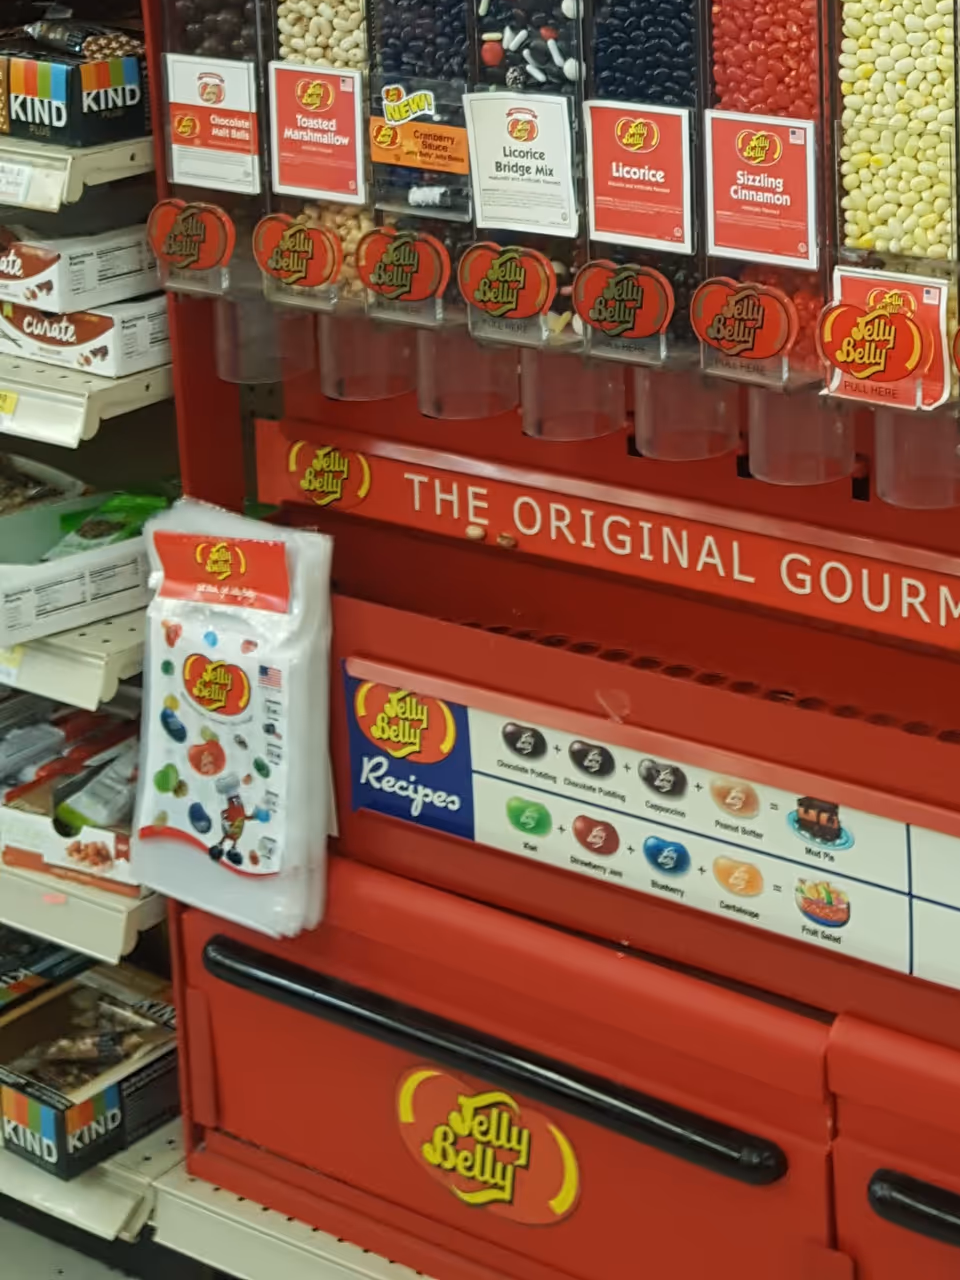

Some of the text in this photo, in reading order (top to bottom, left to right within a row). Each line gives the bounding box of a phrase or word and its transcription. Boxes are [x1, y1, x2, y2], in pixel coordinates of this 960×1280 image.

[10, 93, 67, 128] KIND
[82, 83, 141, 114] KIND
[385, 93, 433, 123] NEW!
[284, 128, 350, 146] Marshmallow
[296, 114, 336, 131] Toasted
[413, 129, 456, 145] Cranberry
[421, 140, 448, 152] Sauce
[502, 146, 546, 161] Licorice
[495, 161, 554, 177] Bridge Mix
[611, 161, 665, 183] Licorice
[736, 170, 784, 192] Sizzling
[730, 185, 791, 207] Cinnamon
[23, 314, 77, 343] curate
[851, 309, 897, 349] Jelly
[836, 337, 888, 379] Belly
[844, 382, 899, 399] PULL HERE
[403, 472, 490, 526] THE
[513, 495, 757, 585] ORIGINAL
[384, 690, 429, 729] Jelly
[370, 714, 422, 759] Belly
[359, 756, 462, 818] Recipes
[804, 846, 835, 863] Mud Pie
[650, 879, 684, 898] Blueberry
[801, 924, 819, 939] Fruit
[2, 1115, 59, 1164] KIND
[68, 1108, 122, 1154] KIND
[447, 1091, 531, 1167] Jelly
[420, 1124, 517, 1205] Belly
